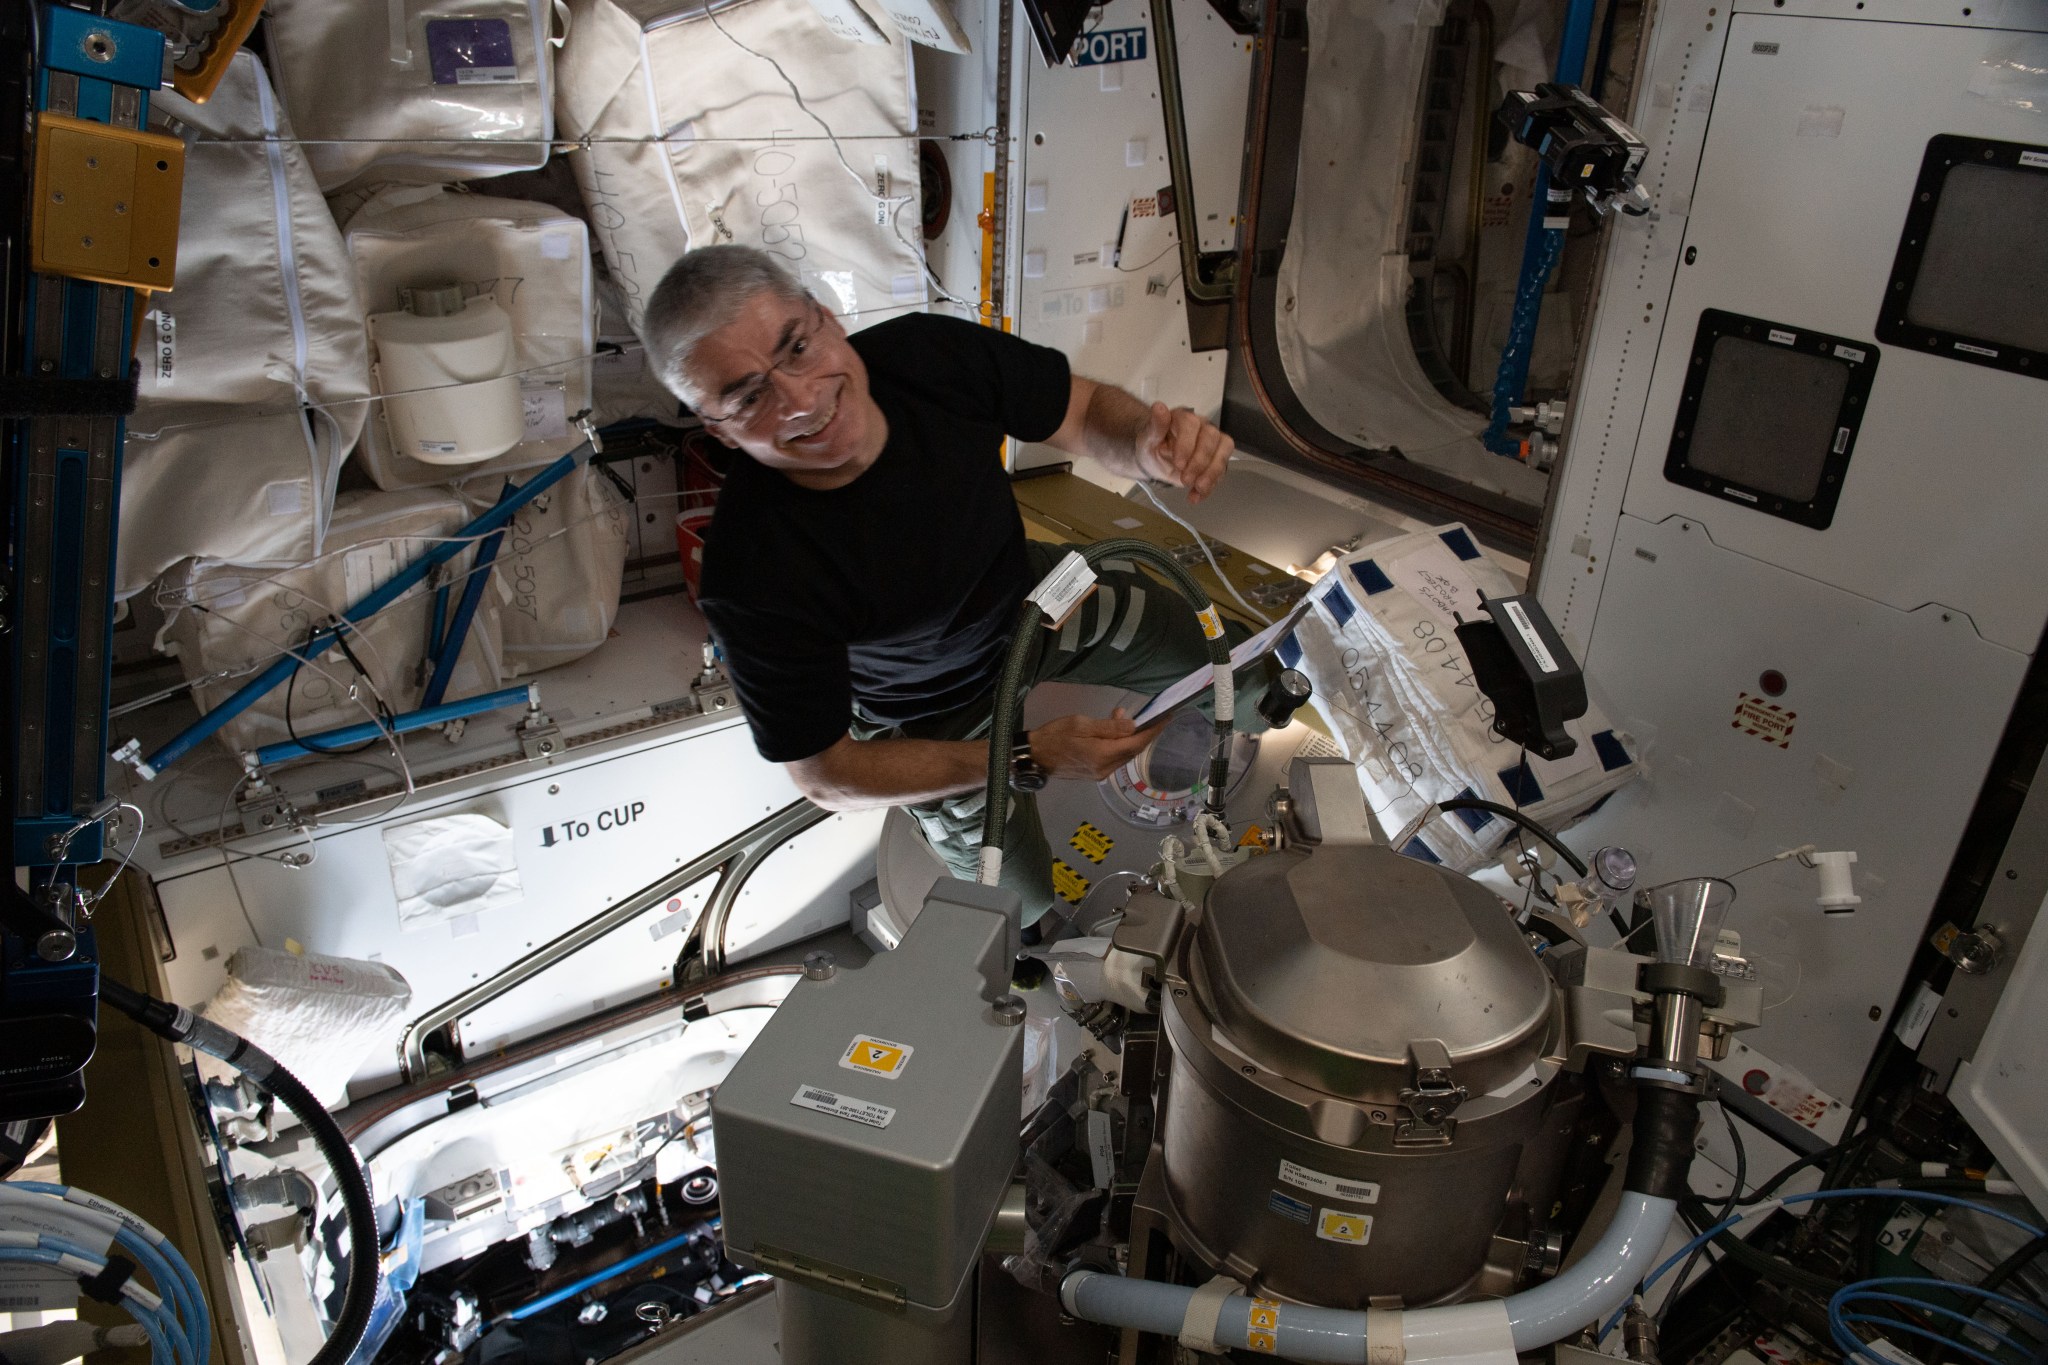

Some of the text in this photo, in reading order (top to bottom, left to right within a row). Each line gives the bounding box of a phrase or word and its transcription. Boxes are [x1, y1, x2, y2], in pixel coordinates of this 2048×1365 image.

[1073, 31, 1143, 62] PORT
[162, 335, 172, 344] G
[161, 347, 172, 378] ZERO
[1843, 348, 1857, 360] Port
[1742, 710, 1785, 732] FIRE PORT
[562, 801, 646, 841] To CUP
[1082, 828, 1106, 850] WARNING
[872, 1049, 883, 1059] 2
[87, 1197, 119, 1220] Ethernet
[117, 1211, 137, 1228] Cable
[1340, 1225, 1348, 1234] 2
[1897, 1228, 1912, 1242] 4
